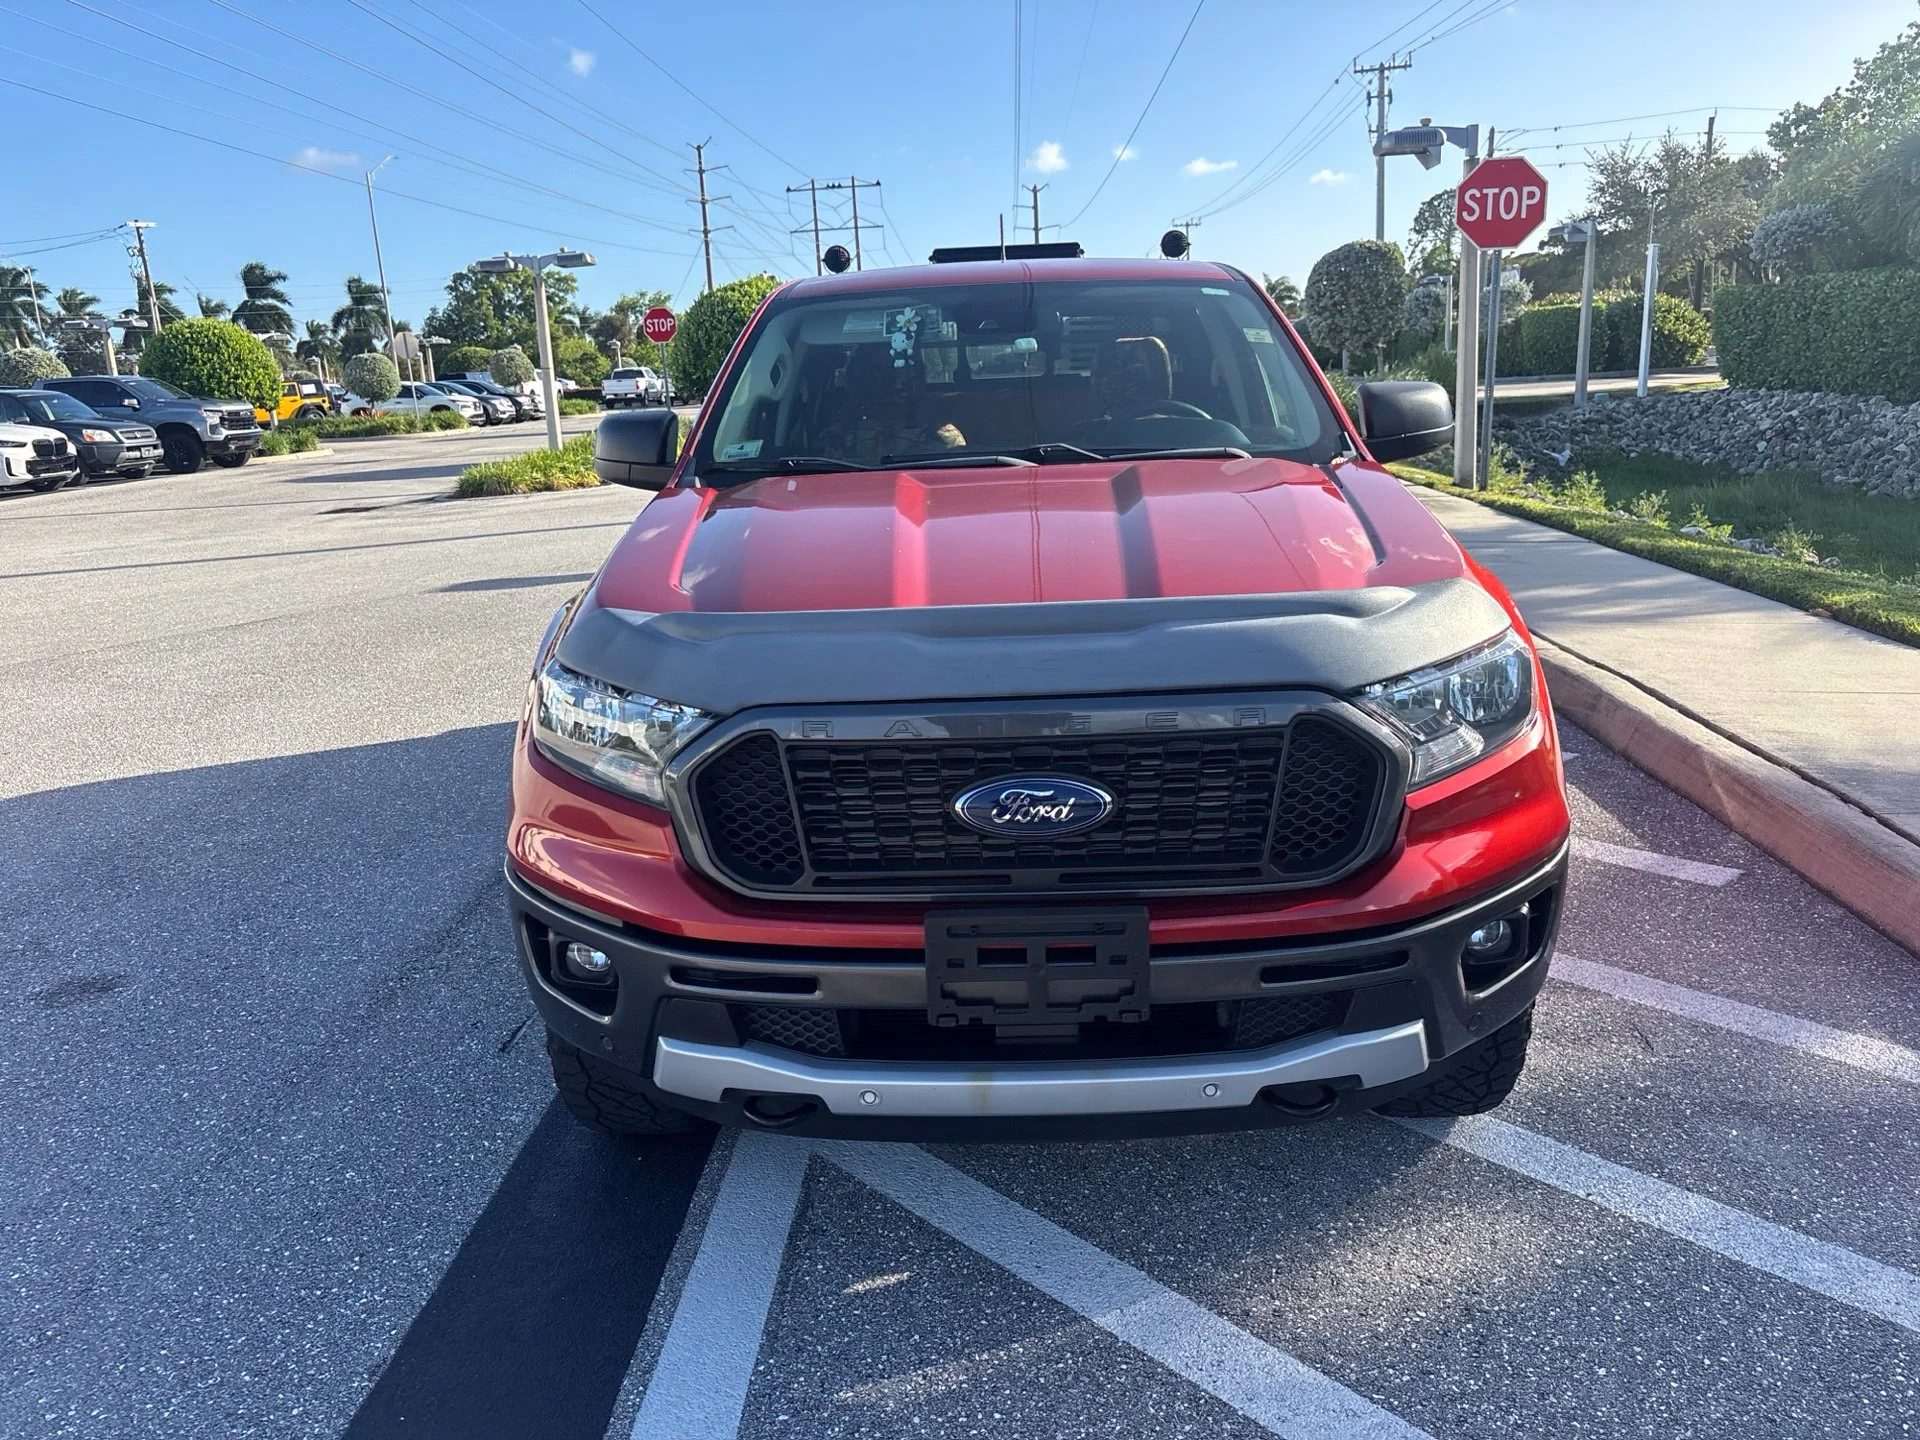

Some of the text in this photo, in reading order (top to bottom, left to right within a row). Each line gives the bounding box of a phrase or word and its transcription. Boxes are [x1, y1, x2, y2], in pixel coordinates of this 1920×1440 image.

[1462, 186, 1541, 221] STOP
[646, 318, 675, 332] STOP
[991, 789, 1076, 824] Ford
